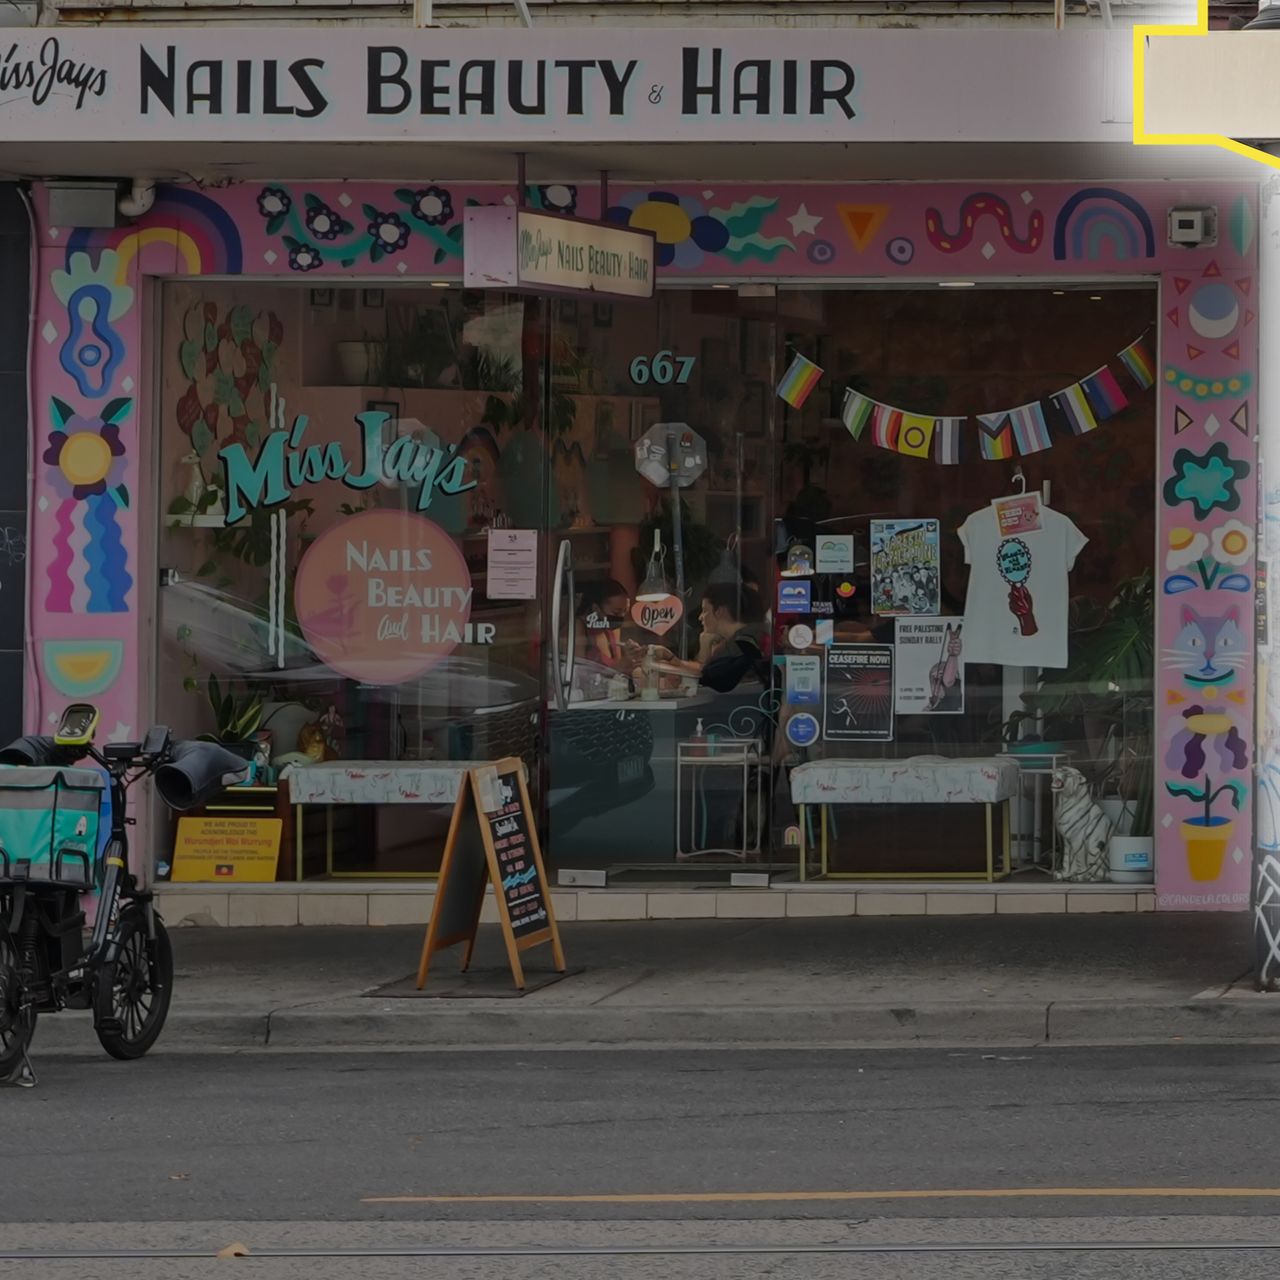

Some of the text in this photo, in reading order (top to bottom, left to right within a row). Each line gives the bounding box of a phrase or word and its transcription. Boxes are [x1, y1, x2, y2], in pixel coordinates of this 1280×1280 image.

[0, 43, 35, 91] iss
[140, 43, 857, 119] NAILS BEAUTY & HAIR
[629, 350, 696, 384] 667
[218, 414, 351, 527] Miss
[346, 540, 432, 571] NAILS
[367, 577, 473, 613] BEAUTY
[421, 614, 496, 644] HAIR
[586, 611, 610, 629] Push
[641, 604, 675, 628] Open
[899, 624, 944, 633] FREE PALESTINE
[925, 636, 942, 644] RALLY
[829, 654, 890, 665] CEASEFIRE NOW!
